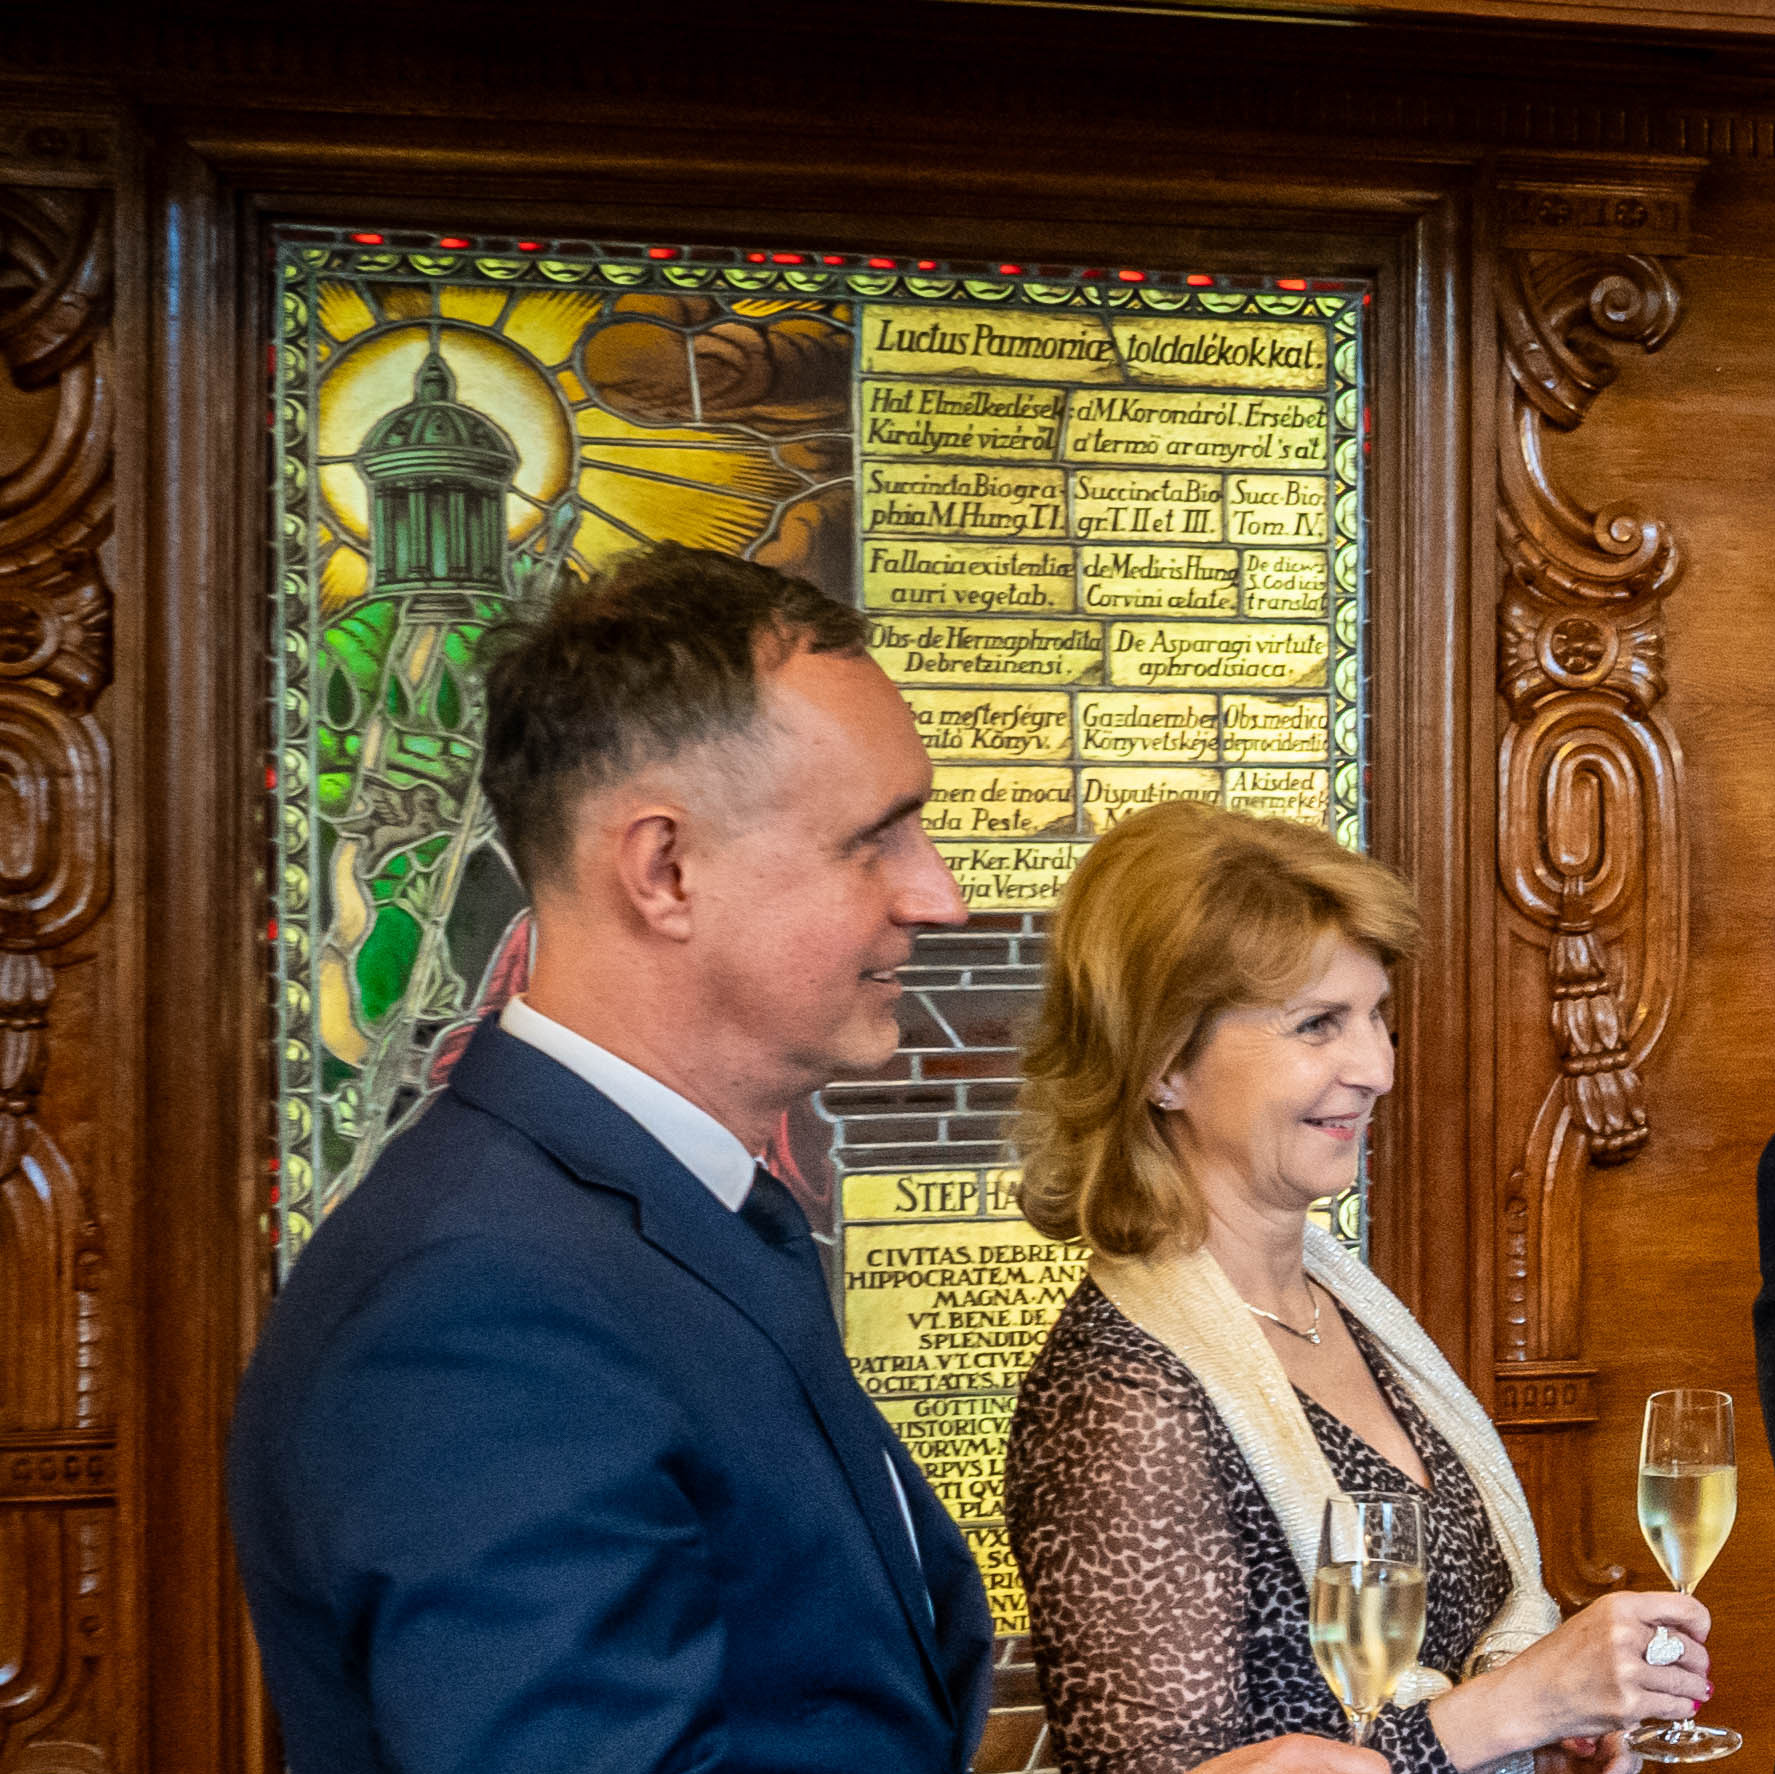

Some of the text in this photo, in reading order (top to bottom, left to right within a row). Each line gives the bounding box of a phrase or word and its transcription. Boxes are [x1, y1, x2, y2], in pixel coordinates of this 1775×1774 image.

[876, 320, 969, 354] Luctus
[870, 388, 913, 413] Hat
[1153, 510, 1173, 533] et
[1083, 554, 1112, 578] de
[891, 583, 1055, 613] auri vegetab.
[1087, 584, 1163, 608] Corvini
[1115, 629, 1145, 652] De
[980, 778, 1009, 802] de
